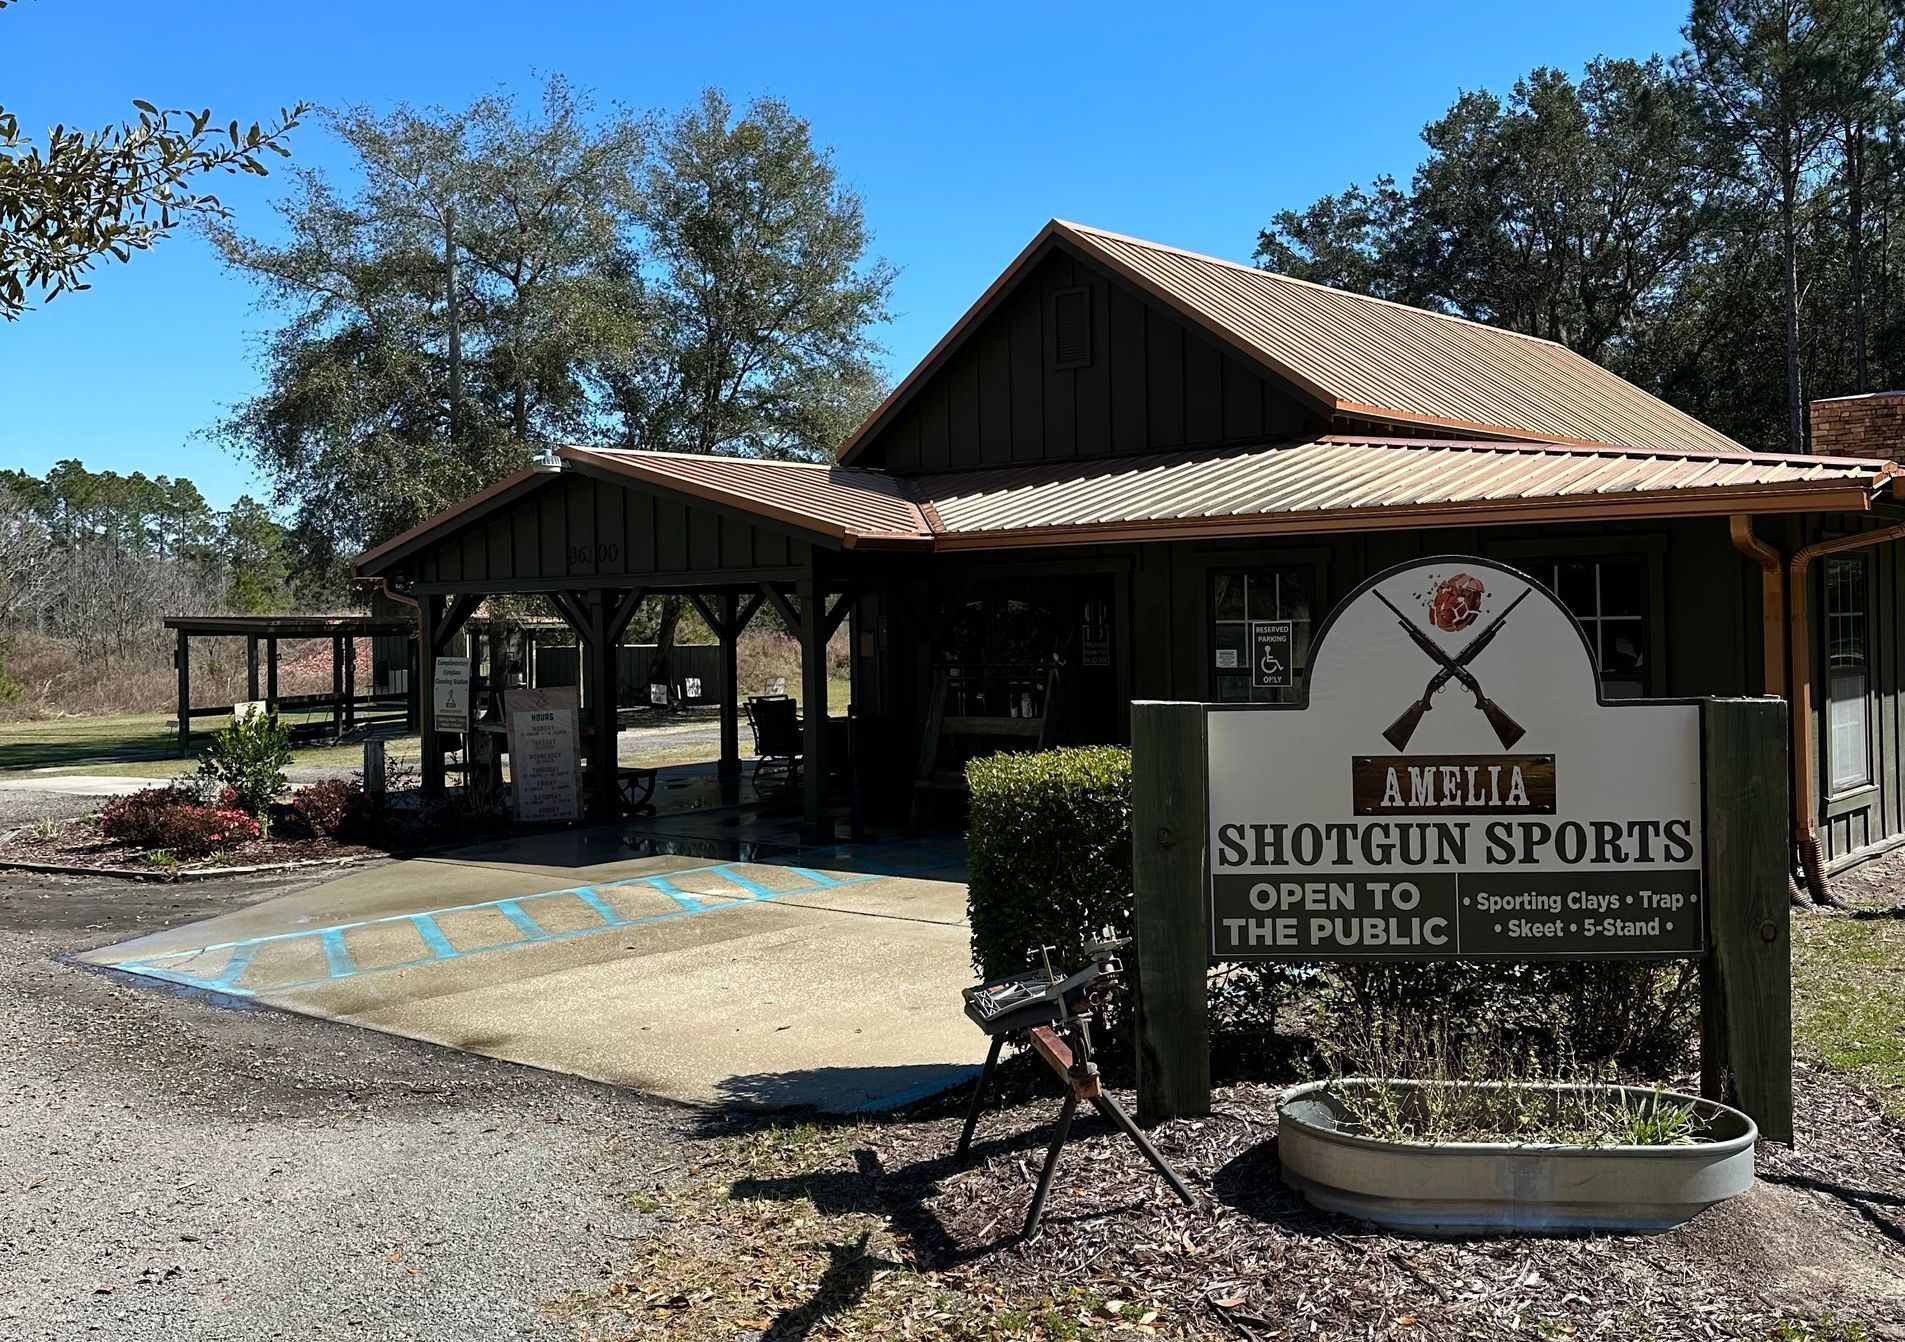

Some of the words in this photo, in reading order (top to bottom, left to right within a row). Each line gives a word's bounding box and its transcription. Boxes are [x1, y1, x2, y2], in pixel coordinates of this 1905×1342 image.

[1258, 635, 1287, 643] PARKING
[531, 713, 554, 722] HOURS
[1380, 765, 1530, 807] AMELIA
[1217, 823, 1471, 867] SHOTGUN
[1485, 819, 1695, 865] SPORTS
[1249, 882, 1356, 911] OPEN
[1367, 882, 1421, 911] TO
[1476, 891, 1562, 915] Sporting
[1567, 891, 1620, 914] Clays
[1639, 890, 1684, 913] Trap
[1222, 918, 1298, 946] THE
[1310, 916, 1449, 946] PUBLIC
[1508, 919, 1564, 938] Skeet
[1583, 918, 1660, 937] 5-Stand
